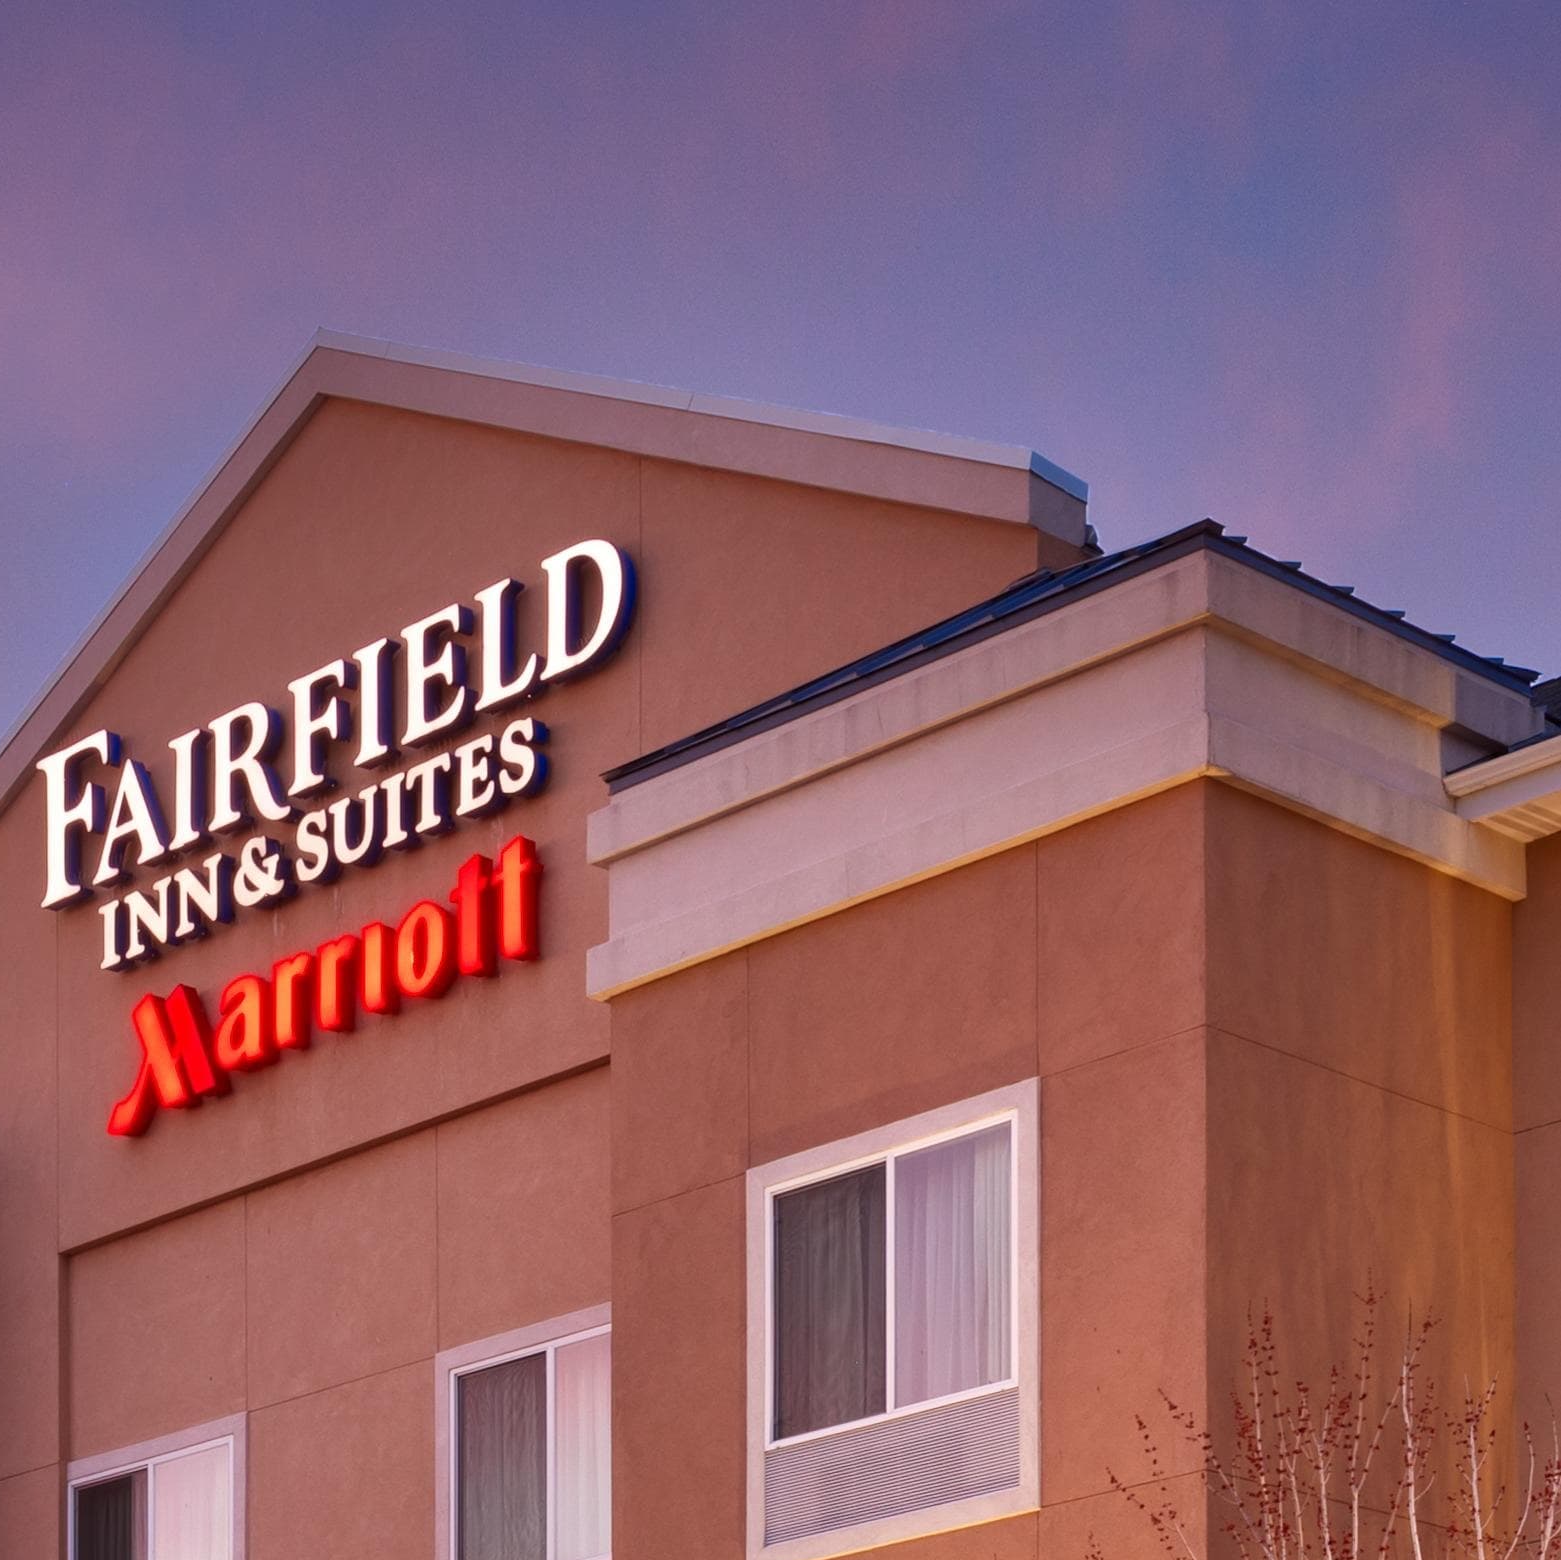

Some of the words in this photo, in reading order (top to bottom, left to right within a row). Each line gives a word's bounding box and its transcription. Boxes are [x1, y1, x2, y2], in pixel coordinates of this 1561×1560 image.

[36, 538, 628, 911] FAIRFIELD
[98, 852, 228, 970] INN
[233, 835, 288, 908] &
[295, 716, 540, 884] SUITES
[107, 835, 542, 1136] Marriott
